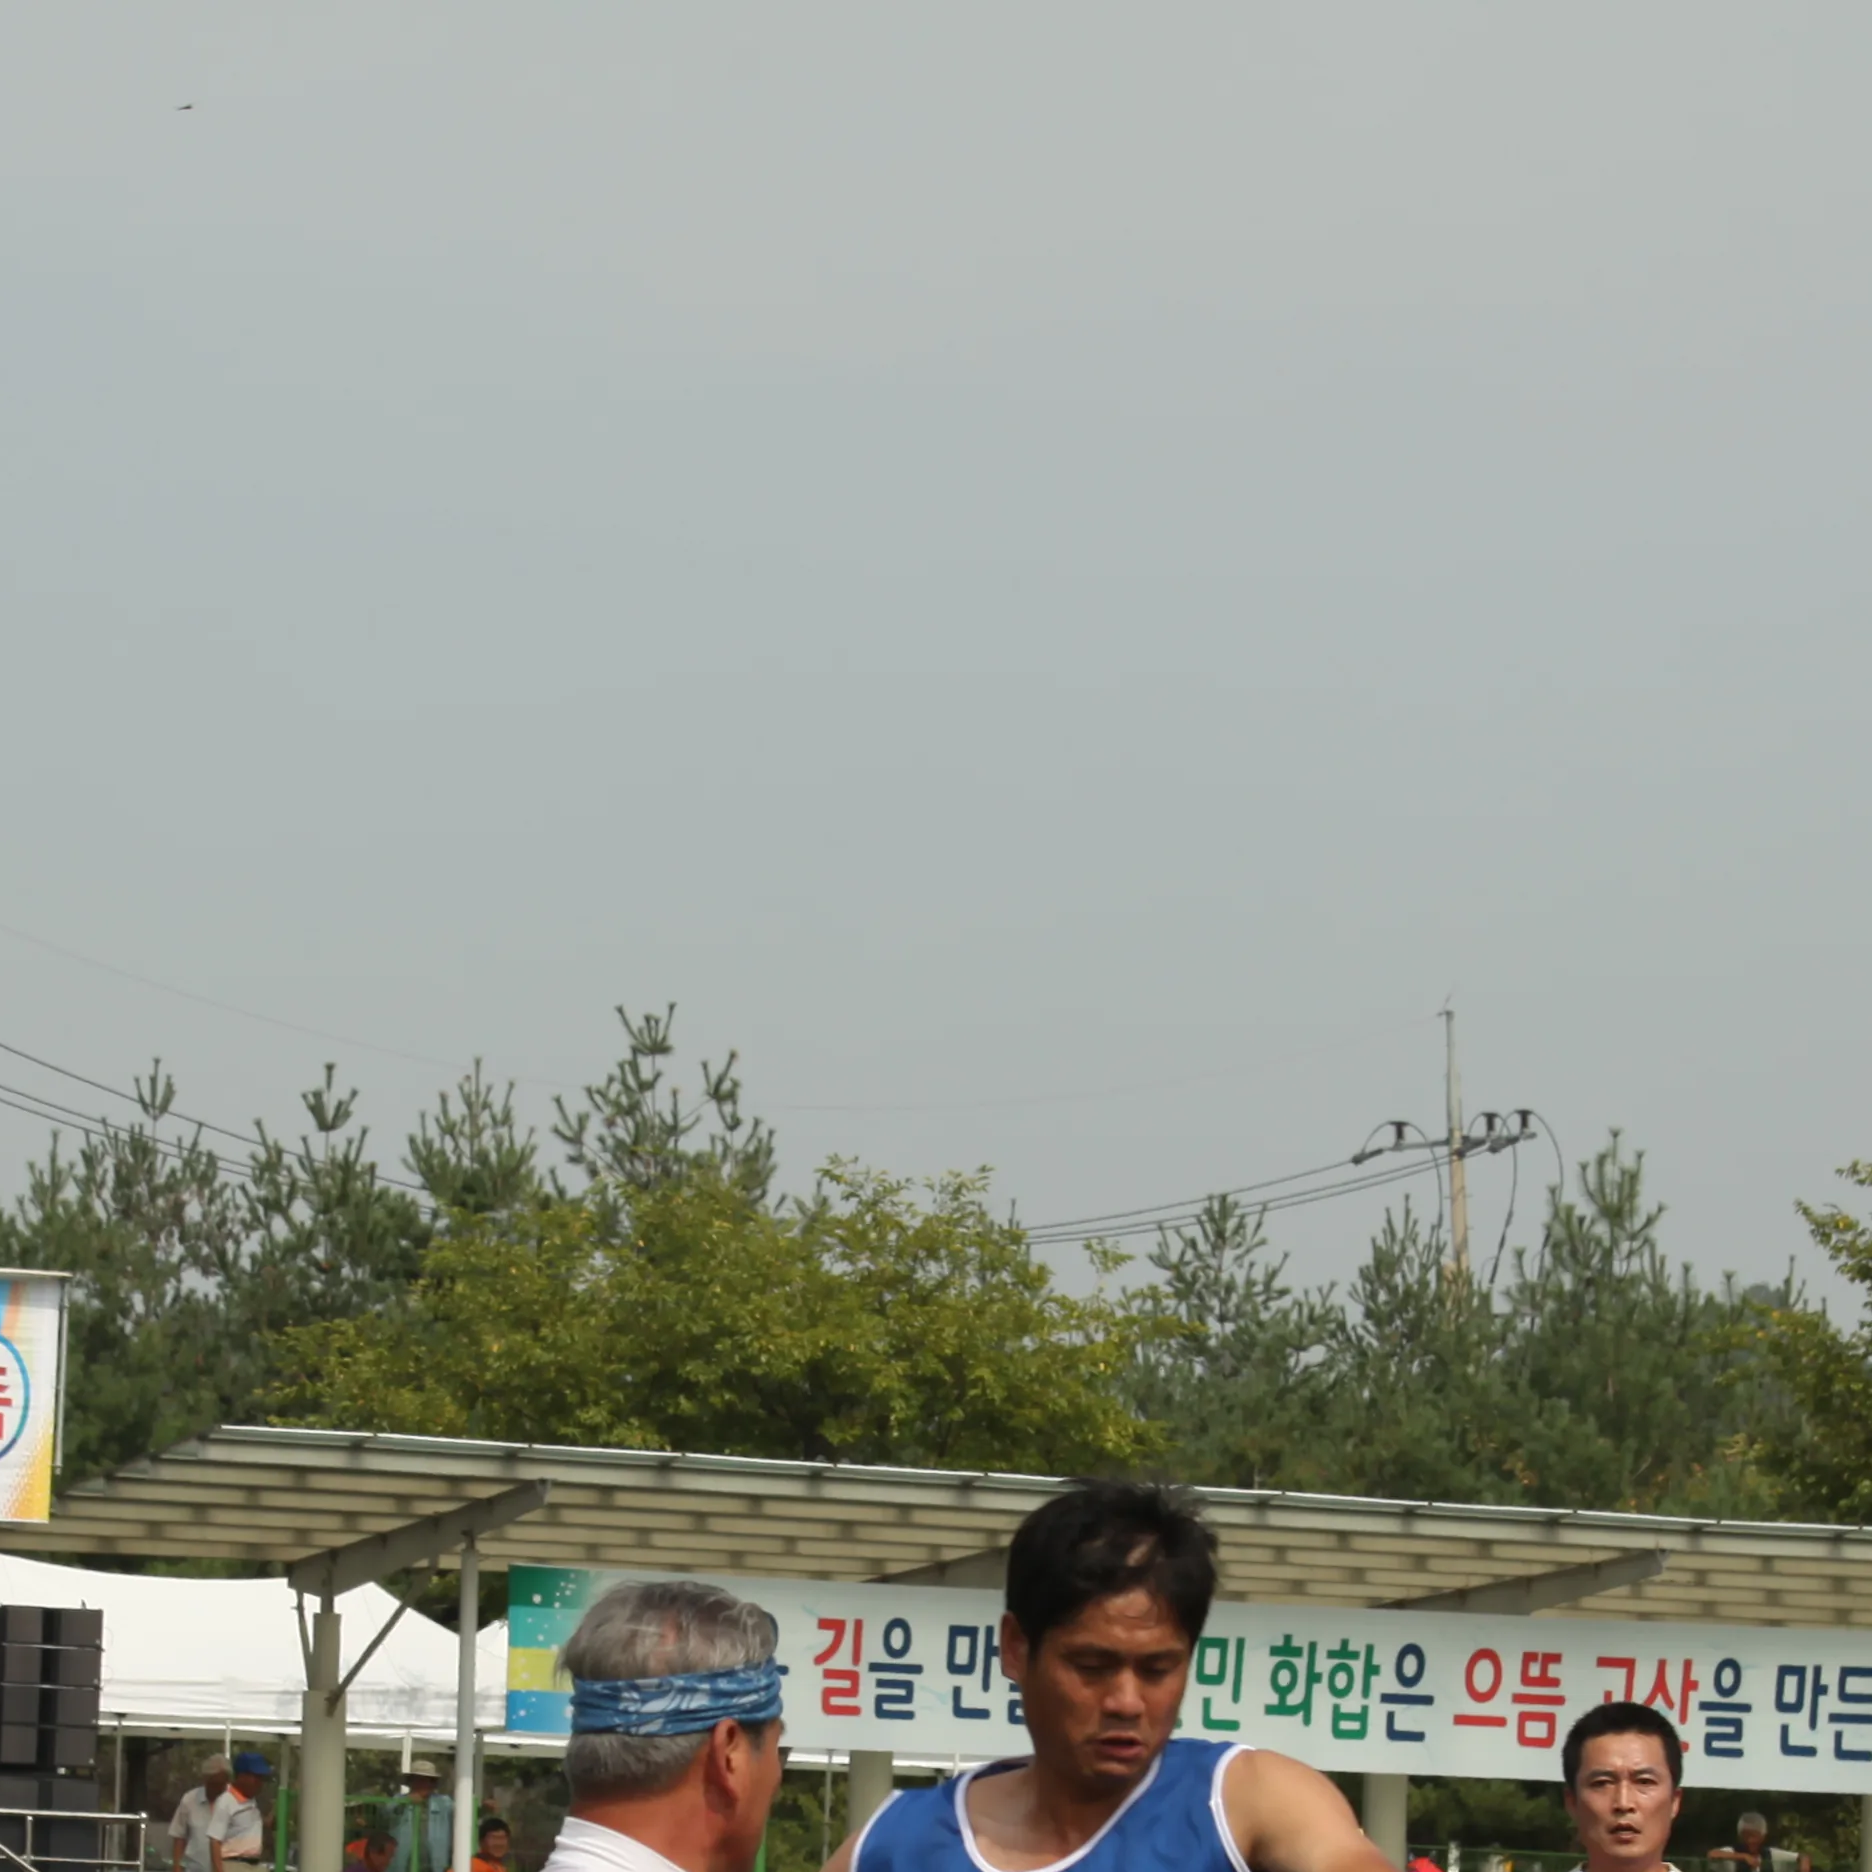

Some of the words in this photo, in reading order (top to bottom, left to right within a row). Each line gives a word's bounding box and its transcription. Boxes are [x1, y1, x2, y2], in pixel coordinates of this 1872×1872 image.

[813, 1616, 924, 1721] 길을
[946, 1624, 1025, 1725] 만
[1173, 1636, 1245, 1732] 민
[1263, 1633, 1435, 1742] 화합은
[1453, 1647, 1566, 1749] 으뜸
[1595, 1656, 1753, 1758] 고산을
